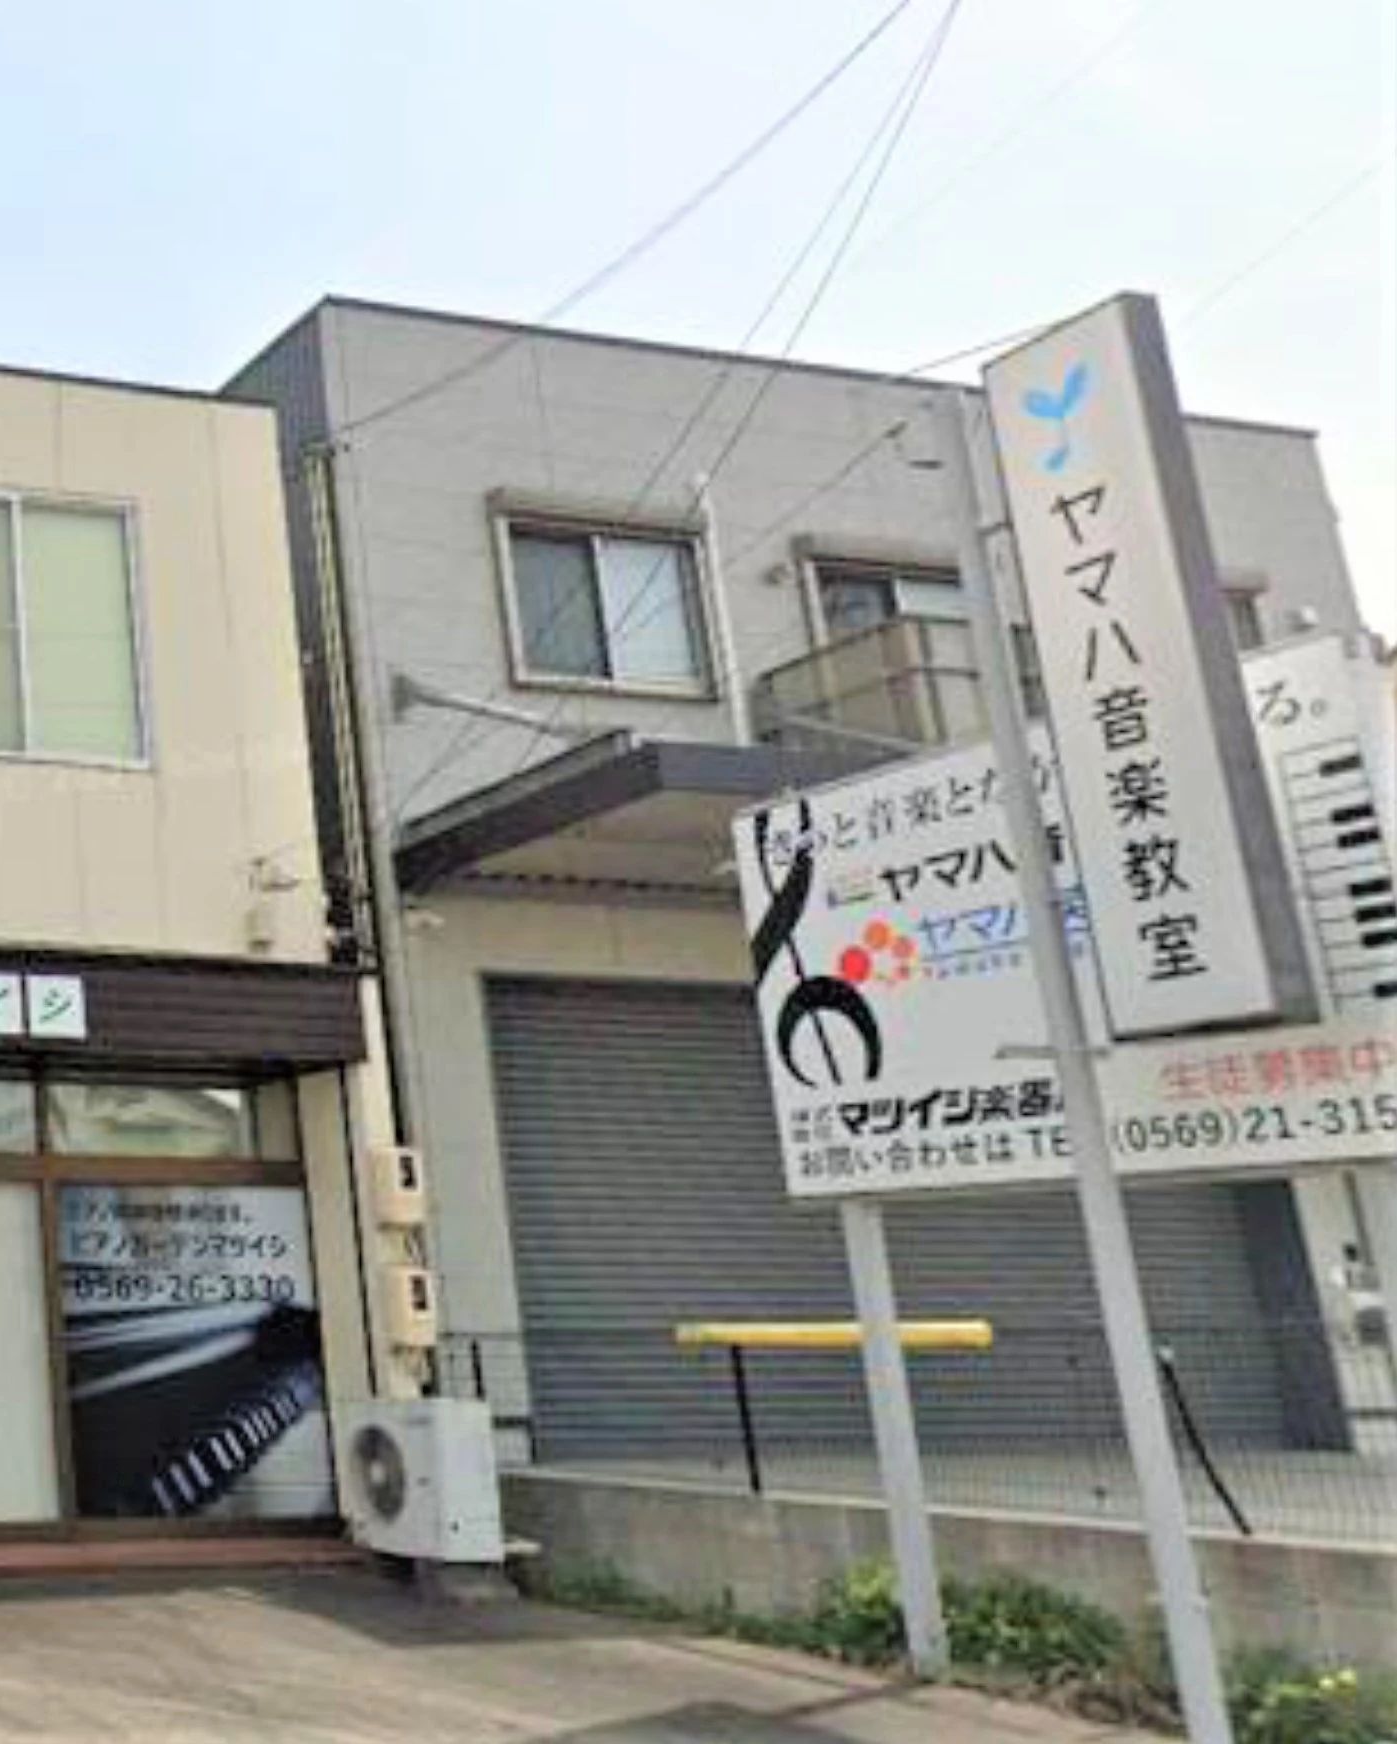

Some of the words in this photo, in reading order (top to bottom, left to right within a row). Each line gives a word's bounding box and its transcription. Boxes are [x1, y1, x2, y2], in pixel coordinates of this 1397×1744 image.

[1049, 485, 1209, 982] ヤマハ音楽教室
[879, 839, 1017, 900] ヤマハ
[1159, 1039, 1395, 1102] 生徒募集中
[837, 1078, 1064, 1135] マツイシ楽器
[799, 1132, 1014, 1177] お問い合わせは
[1026, 1125, 1072, 1158] TE
[68, 1230, 289, 1259] ピアノガーデンマツイシ
[73, 1273, 295, 1302] 0569-26-3330
